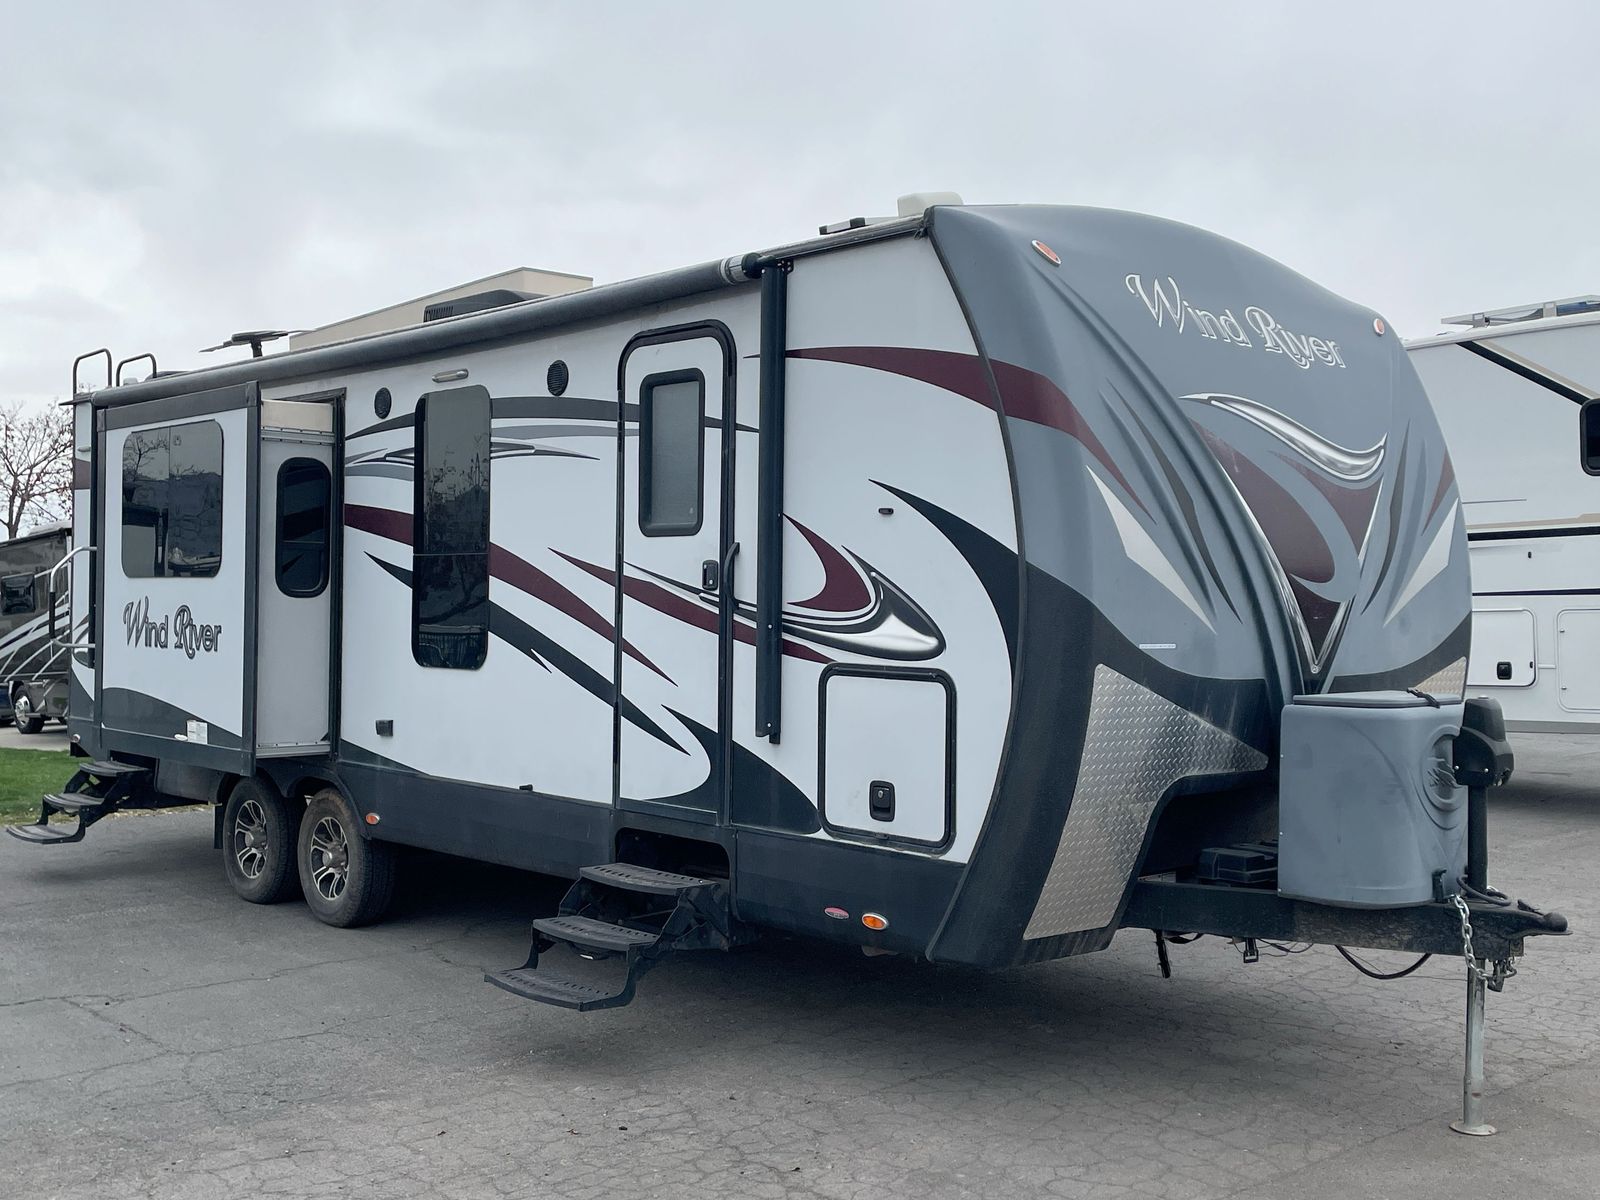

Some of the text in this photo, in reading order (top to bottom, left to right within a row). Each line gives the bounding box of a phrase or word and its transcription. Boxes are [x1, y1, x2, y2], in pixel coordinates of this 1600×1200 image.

[1125, 273, 1347, 369] Wind River
[123, 595, 222, 660] Wind River
